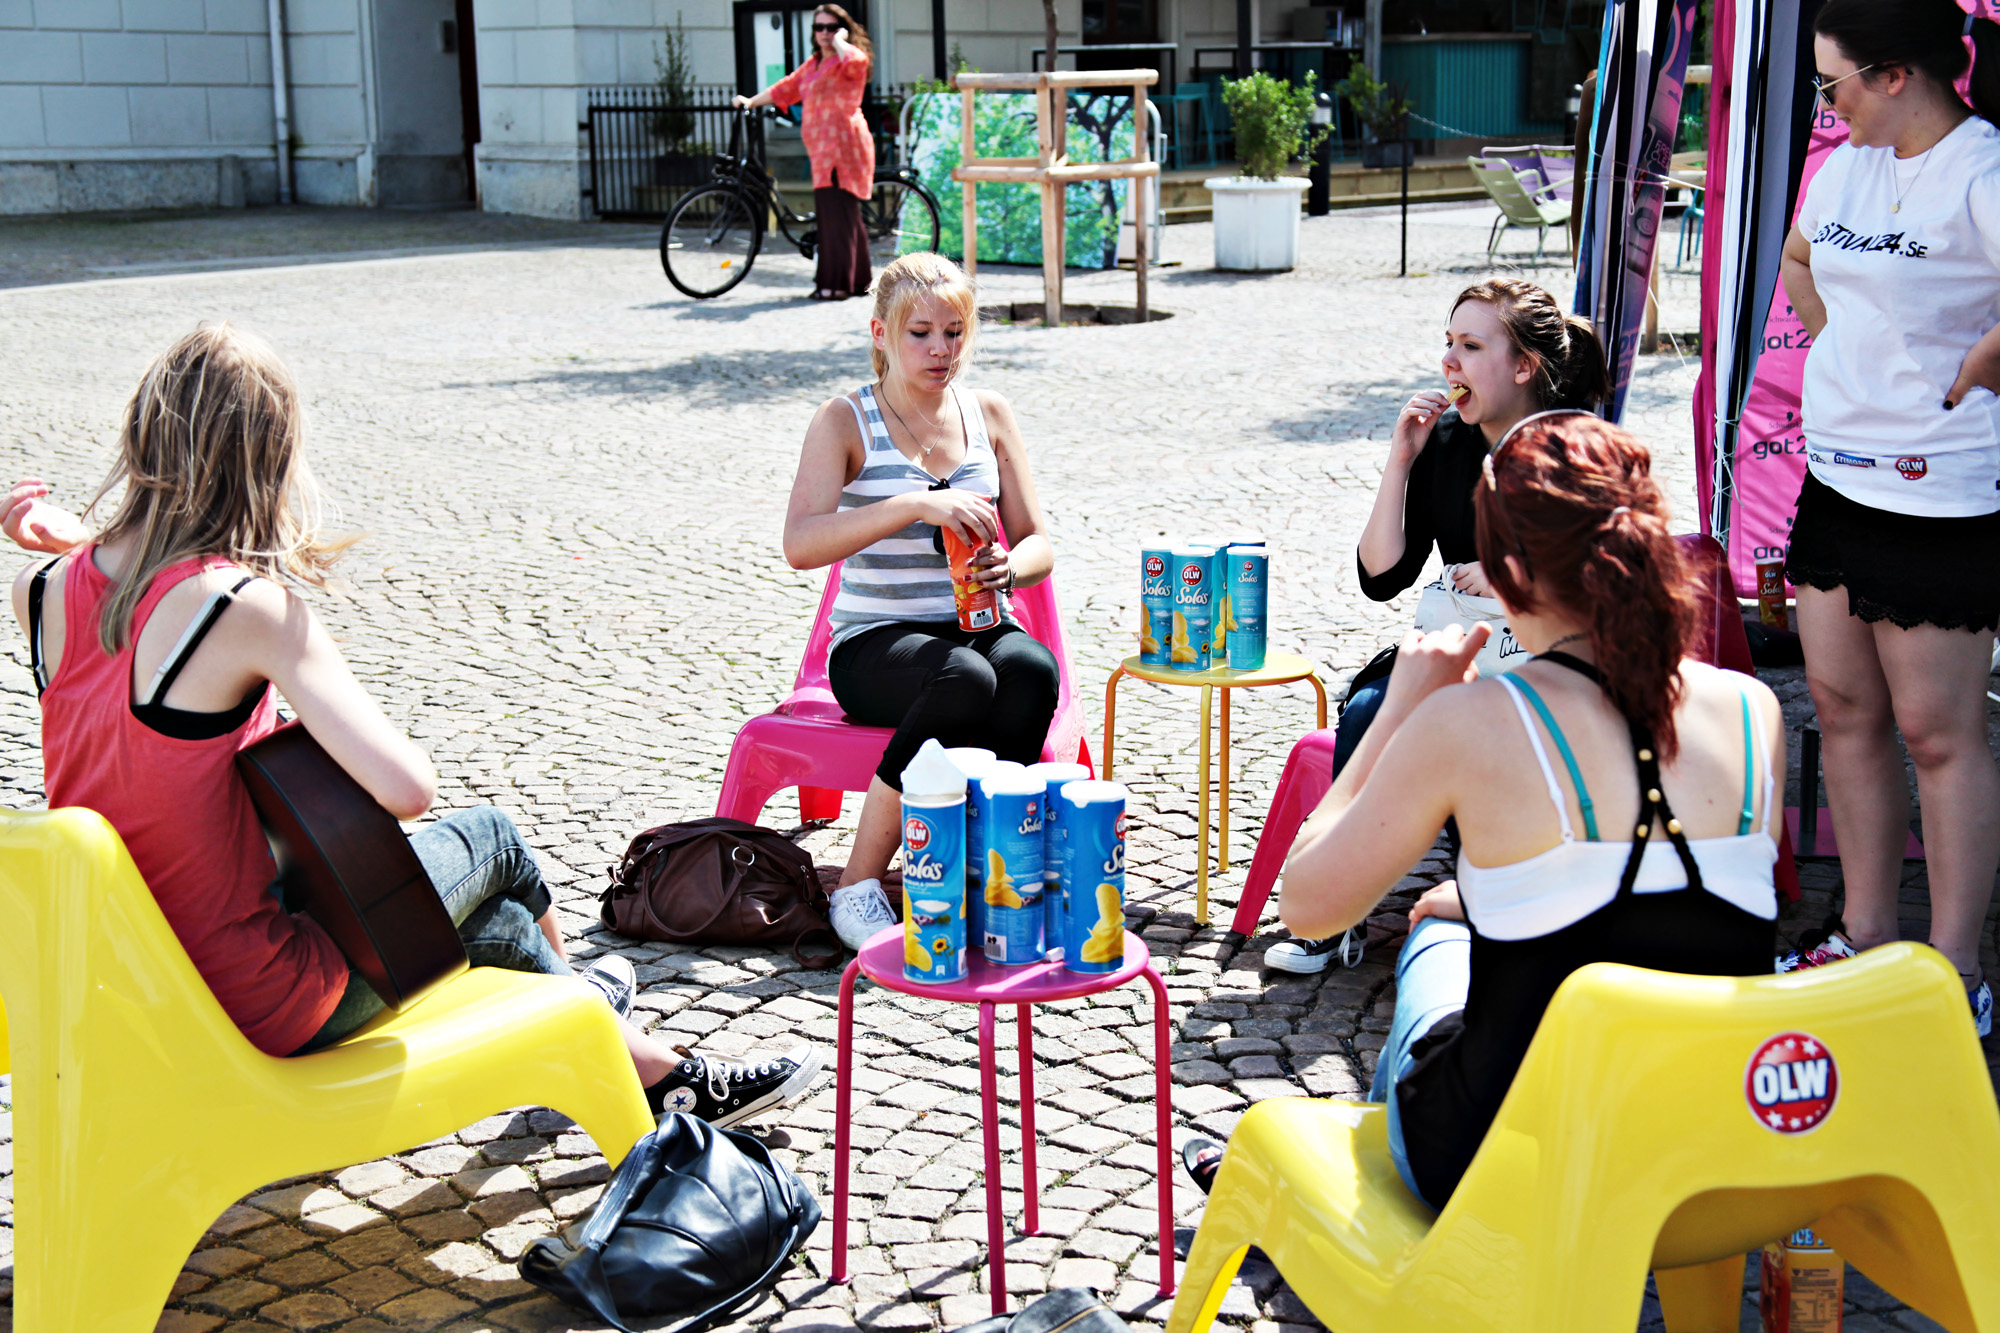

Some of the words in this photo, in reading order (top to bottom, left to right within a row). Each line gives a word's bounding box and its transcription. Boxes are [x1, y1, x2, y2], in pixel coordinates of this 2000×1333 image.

[1897, 460, 1924, 473] OLW
[1146, 562, 1162, 571] OLW
[1183, 570, 1201, 580] OLW
[906, 827, 927, 842] OLW
[1753, 1057, 1829, 1107] OLW
